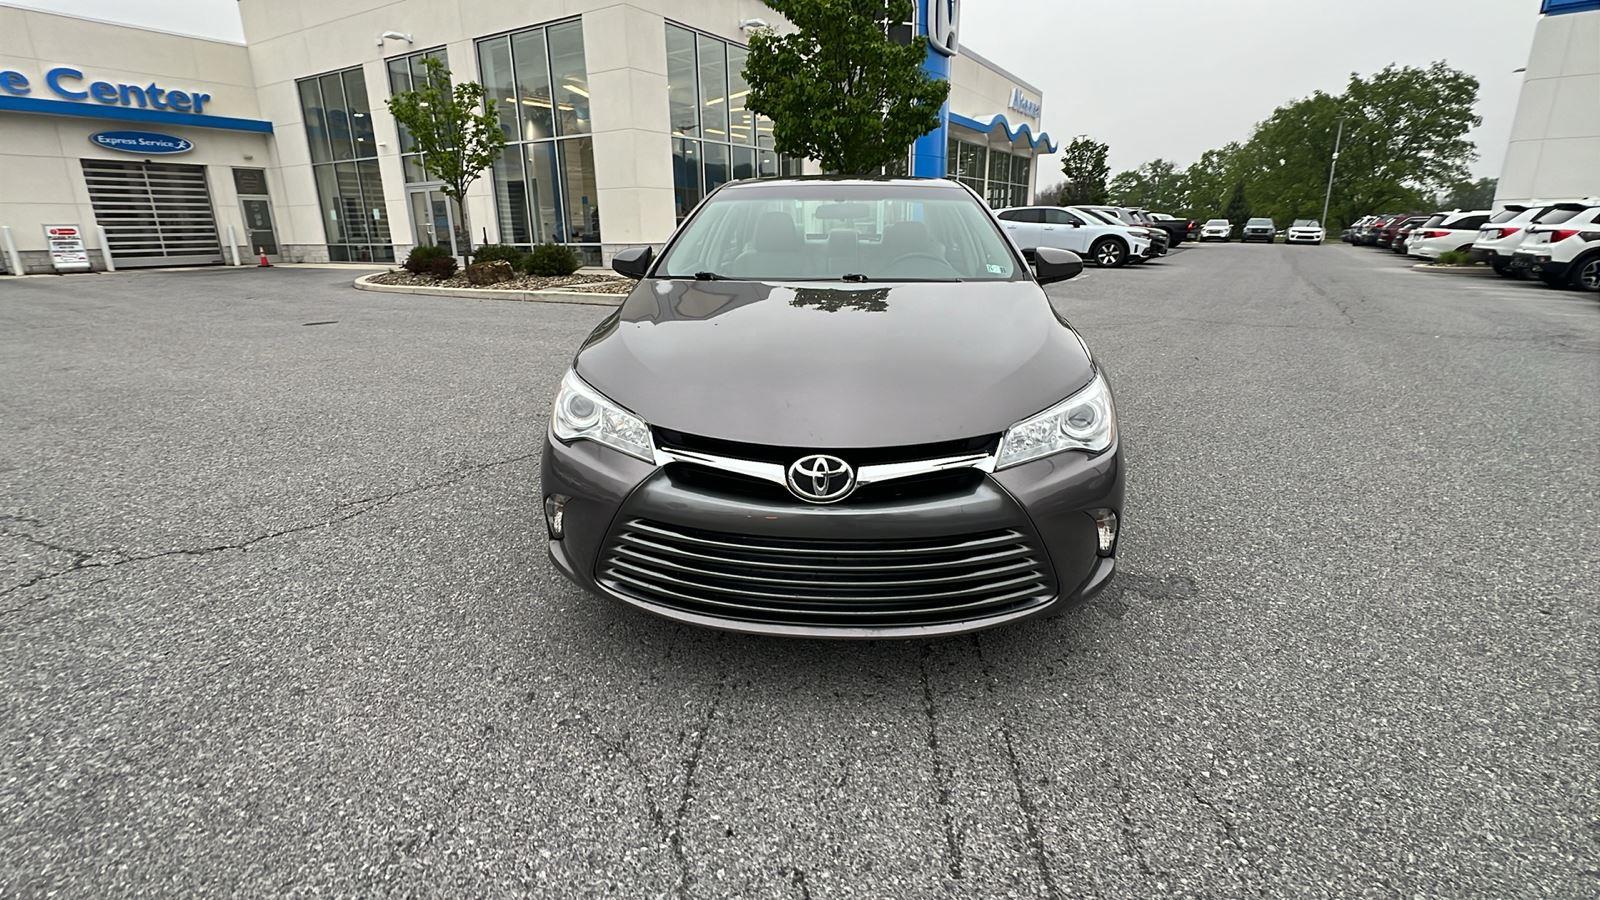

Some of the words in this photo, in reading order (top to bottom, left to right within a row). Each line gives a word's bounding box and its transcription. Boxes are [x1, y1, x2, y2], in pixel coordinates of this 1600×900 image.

[46, 67, 211, 113] Center
[97, 135, 137, 145] Express
[138, 138, 174, 148] Service
